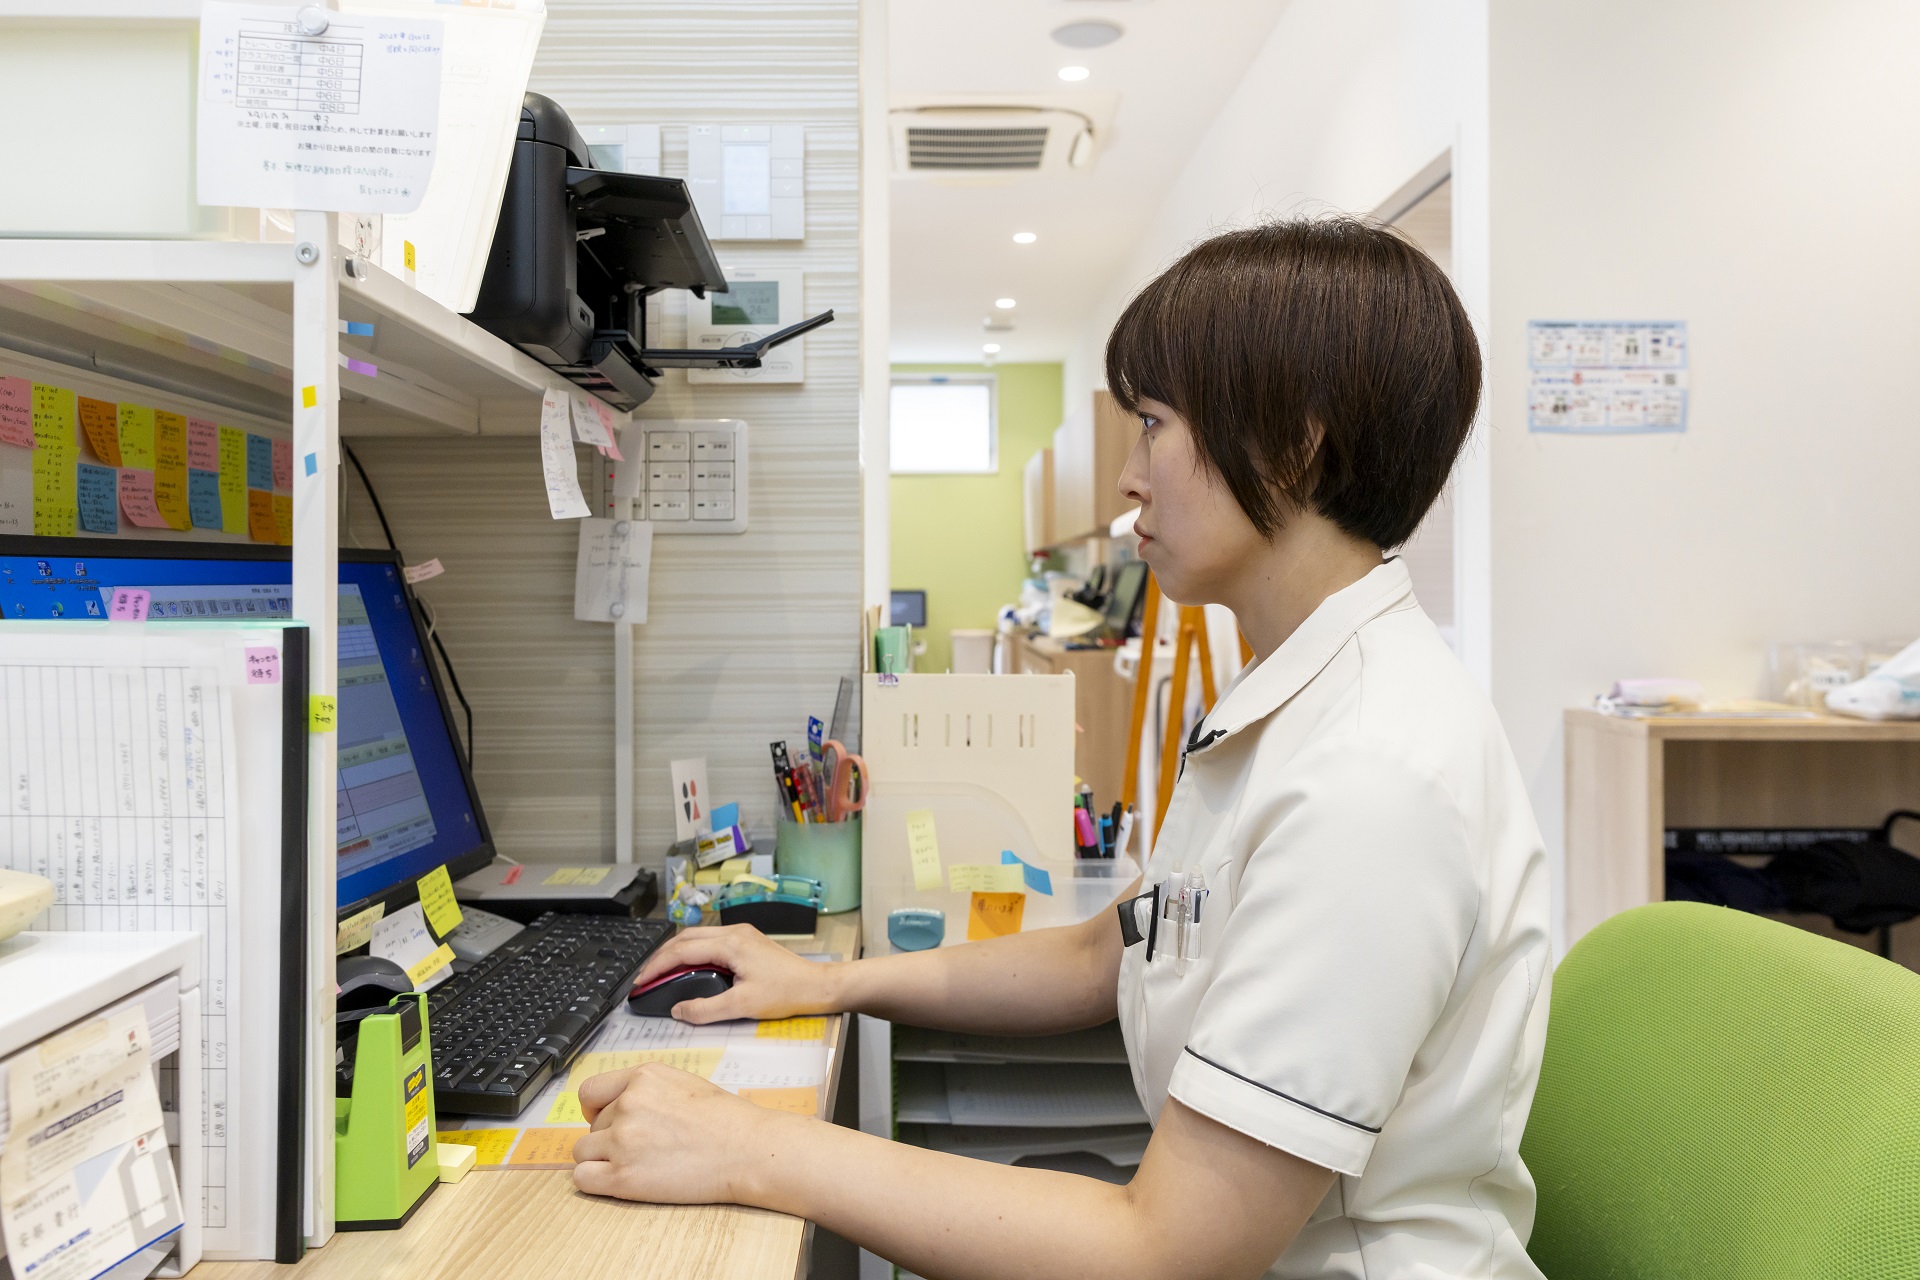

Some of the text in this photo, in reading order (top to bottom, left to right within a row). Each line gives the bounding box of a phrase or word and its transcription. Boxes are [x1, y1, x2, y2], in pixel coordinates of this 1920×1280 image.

[319, 44, 345, 54] 中4日
[318, 56, 345, 66] 中6日
[317, 67, 344, 77] 中5日
[317, 79, 343, 89] 中6日
[316, 91, 342, 101] 中6日
[319, 102, 345, 113] 中8日
[297, 143, 432, 157] お預かり日と納品日の間の日数になります
[248, 654, 279, 664] キャンセル
[250, 668, 273, 679] 待ち
